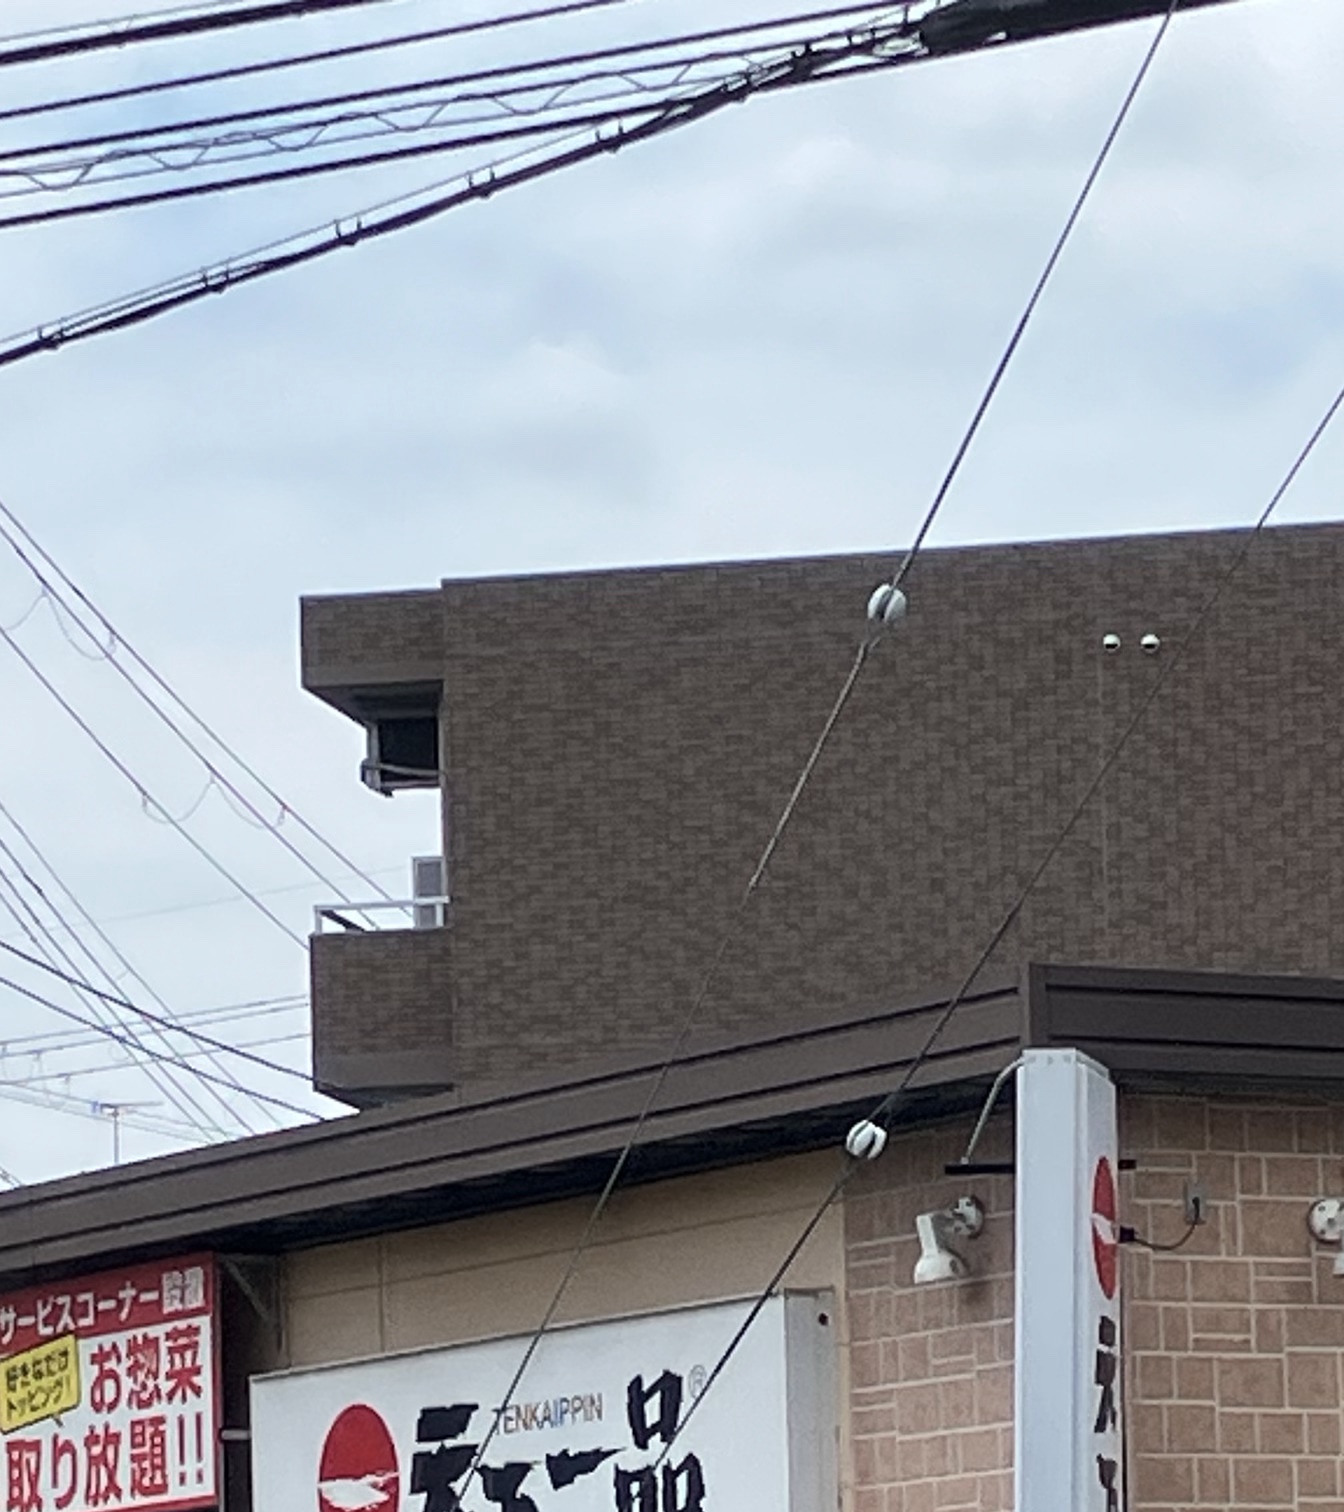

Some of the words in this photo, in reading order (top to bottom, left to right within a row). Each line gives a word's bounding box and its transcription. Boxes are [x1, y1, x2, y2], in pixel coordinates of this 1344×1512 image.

[90, 1323, 204, 1415] お惣菜
[490, 1392, 604, 1437] TENKAIPPIN
